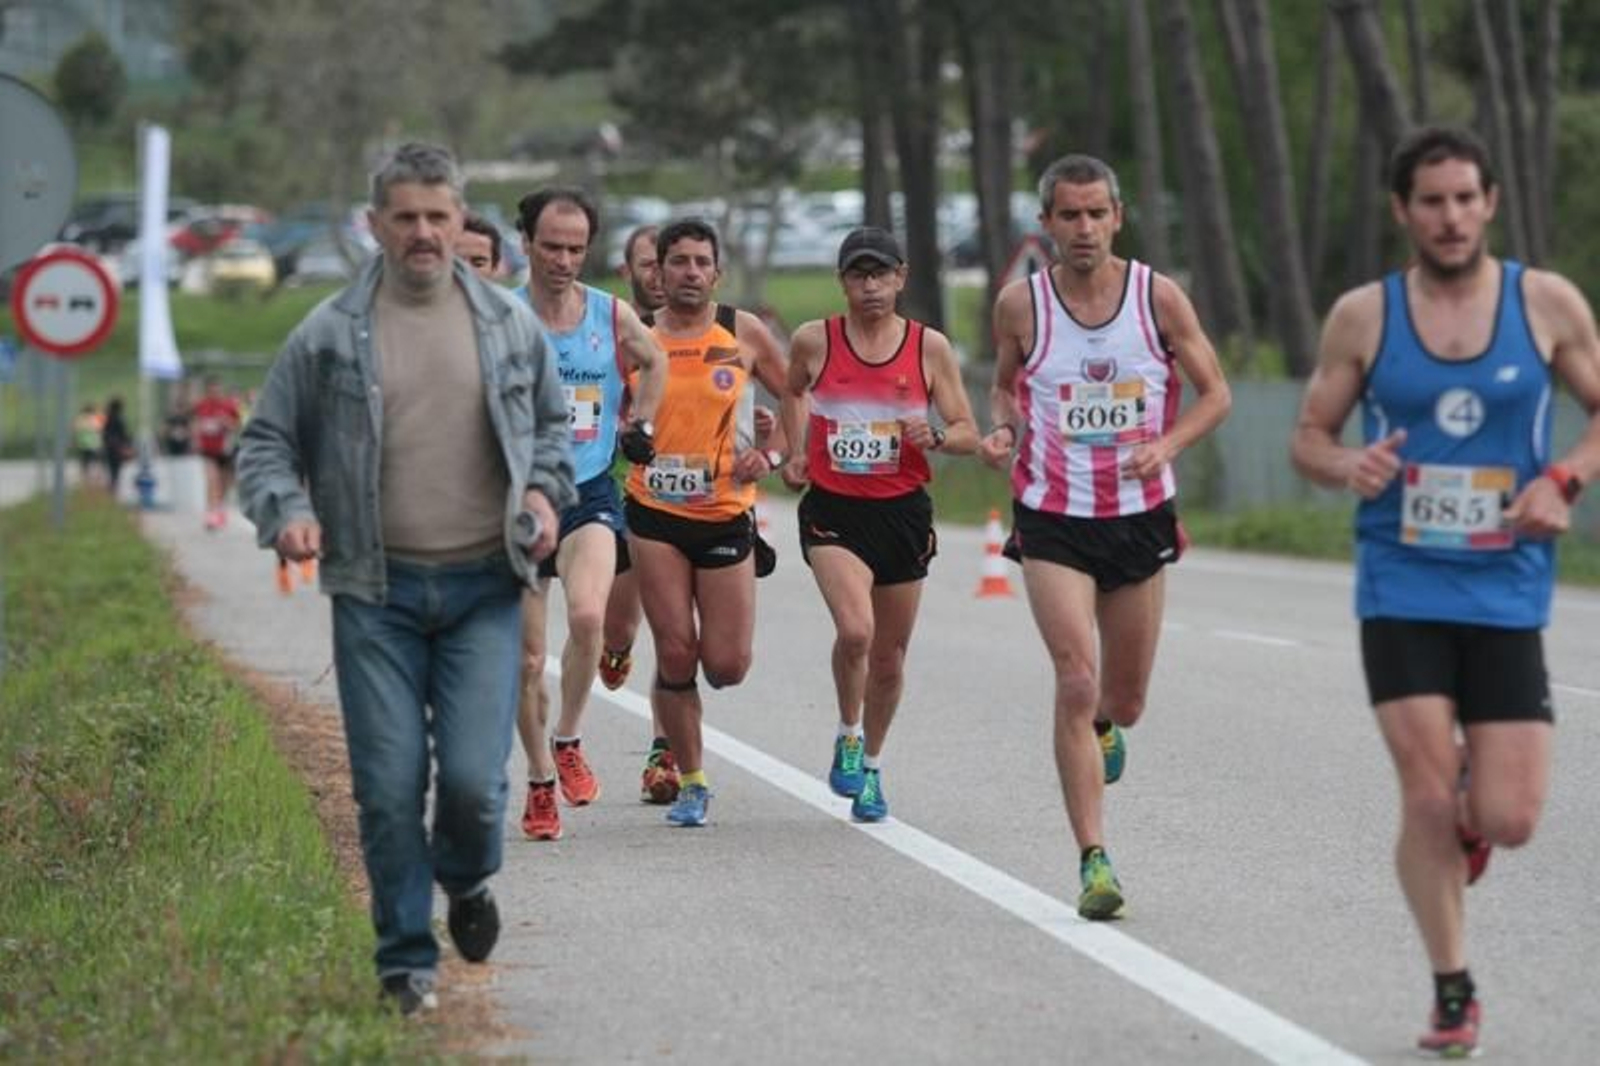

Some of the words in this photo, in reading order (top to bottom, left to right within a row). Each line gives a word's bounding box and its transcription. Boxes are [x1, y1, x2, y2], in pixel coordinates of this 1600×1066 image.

[1067, 405, 1127, 430] 606
[1447, 395, 1477, 432] 4
[833, 439, 881, 459] 693
[649, 473, 696, 492] 676
[1411, 495, 1485, 526] 685
